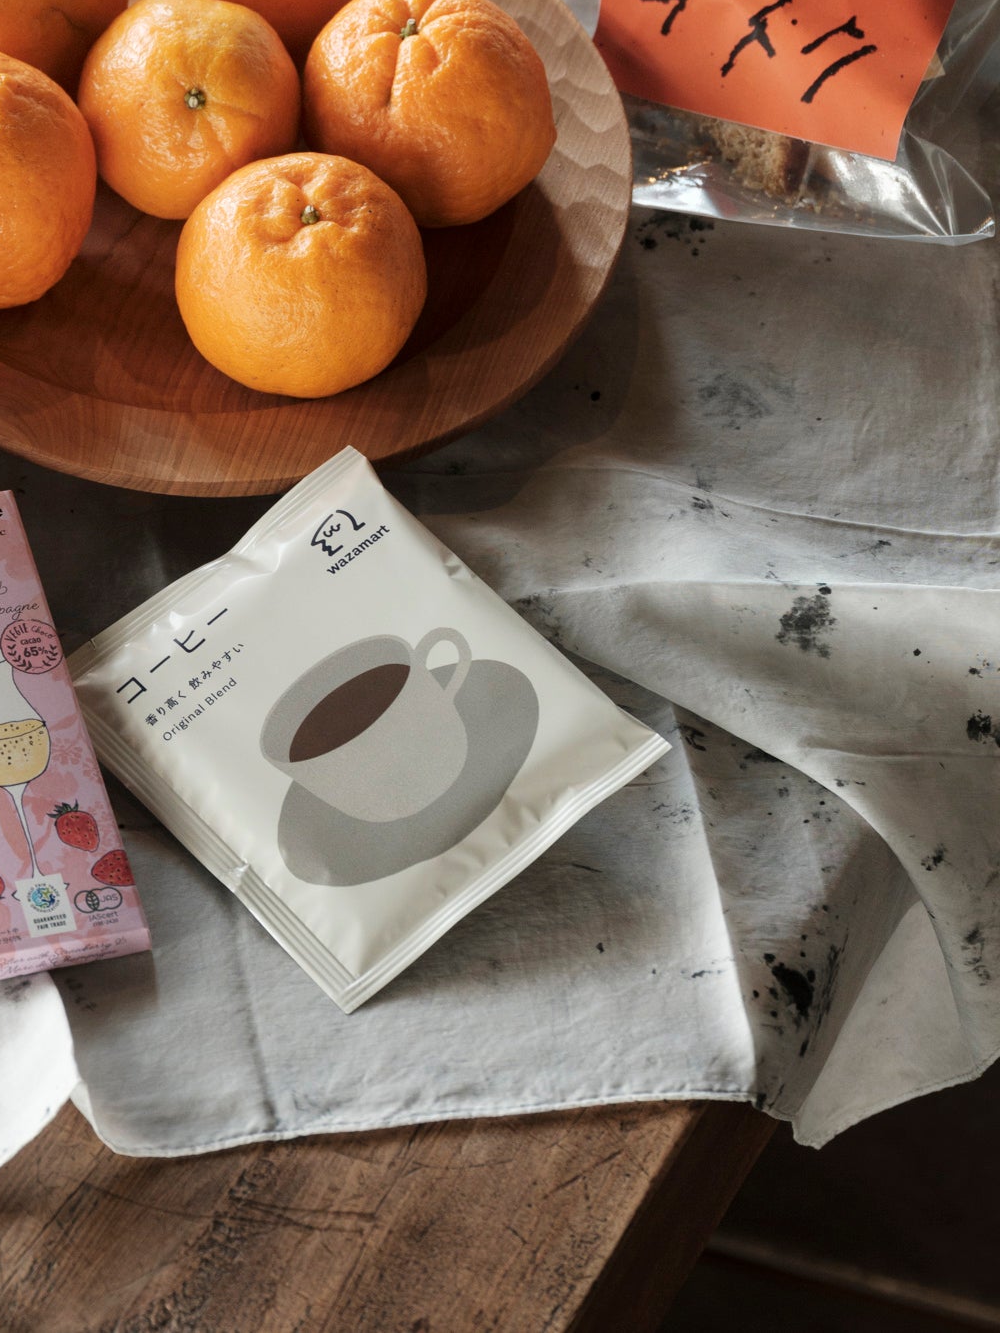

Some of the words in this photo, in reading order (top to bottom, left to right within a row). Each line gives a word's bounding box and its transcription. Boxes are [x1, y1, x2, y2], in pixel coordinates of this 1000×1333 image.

[326, 525, 391, 575] wazamart
[20, 637, 42, 645] cacao
[23, 646, 50, 657] 65%
[116, 608, 228, 704] コーヒー
[145, 689, 187, 727] 香り高く
[188, 643, 245, 690] 飲みやすい
[162, 703, 206, 742] Original
[204, 677, 238, 706] Blend
[33, 913, 67, 924] GUARANTEED
[36, 922, 49, 930] FAIR
[49, 920, 67, 928] TRADE
